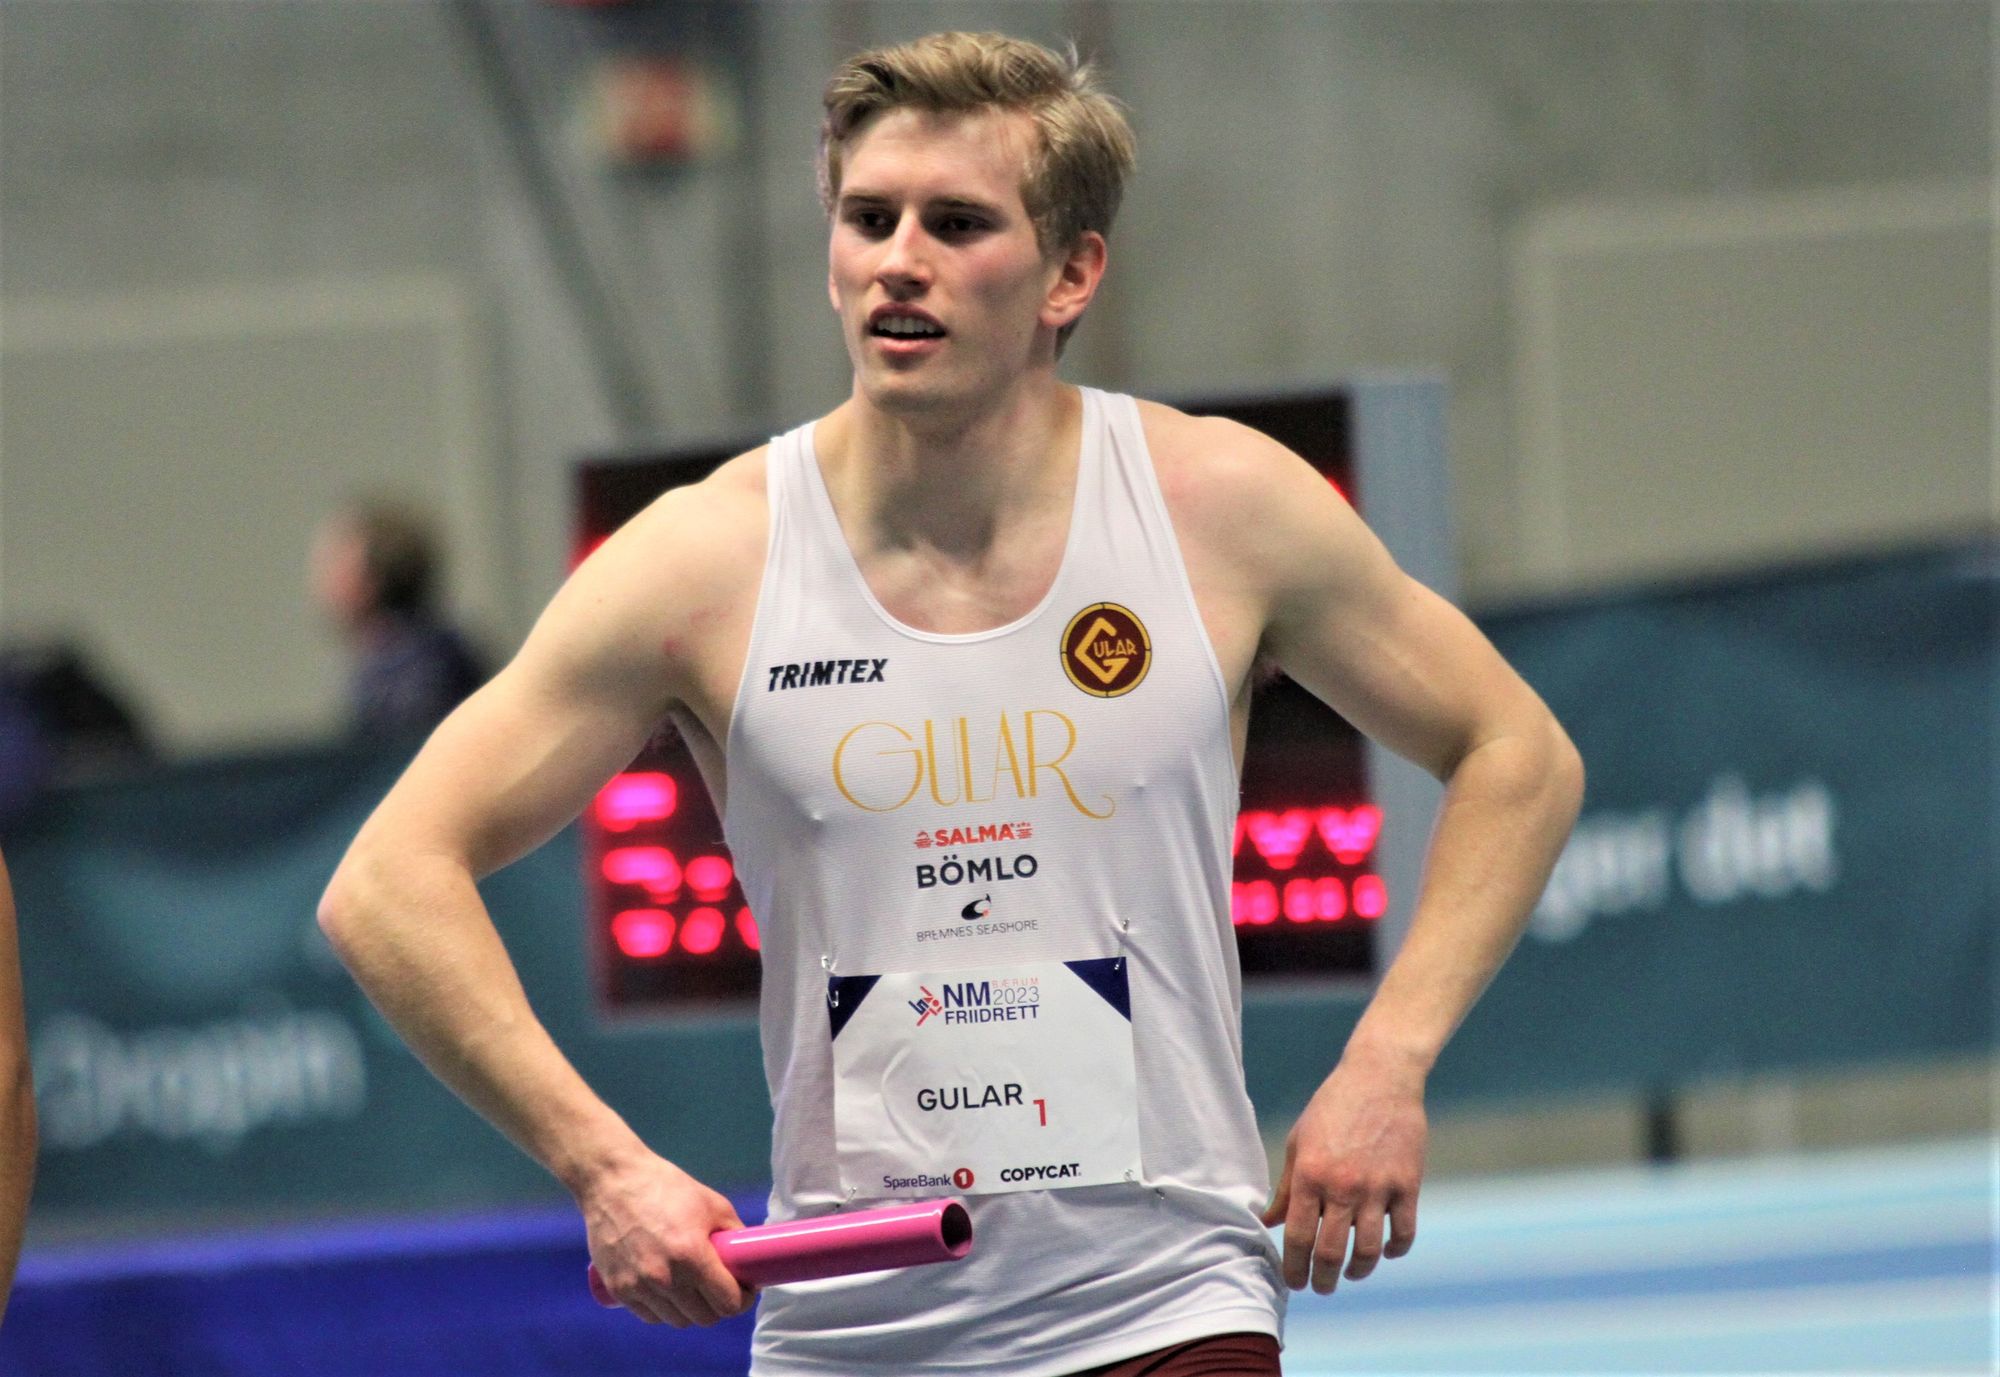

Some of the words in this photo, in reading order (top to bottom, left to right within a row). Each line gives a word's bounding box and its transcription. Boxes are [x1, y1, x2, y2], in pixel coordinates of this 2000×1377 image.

[768, 658, 888, 691] TRIMTEX
[833, 709, 1116, 819] GULAR
[935, 823, 1014, 847] SALMA
[916, 854, 1038, 889] BÖMLO
[916, 925, 974, 942] BREMNES
[976, 919, 1039, 936] SEASHORE
[943, 981, 991, 1008] NM
[993, 986, 1040, 1006] 2023
[945, 1004, 1040, 1024] FRIIDRETT
[917, 1083, 1023, 1110] GULAR
[1033, 1098, 1047, 1127] 1
[883, 1174, 951, 1190] SpareBank
[1000, 1163, 1080, 1182] COPYCAT
